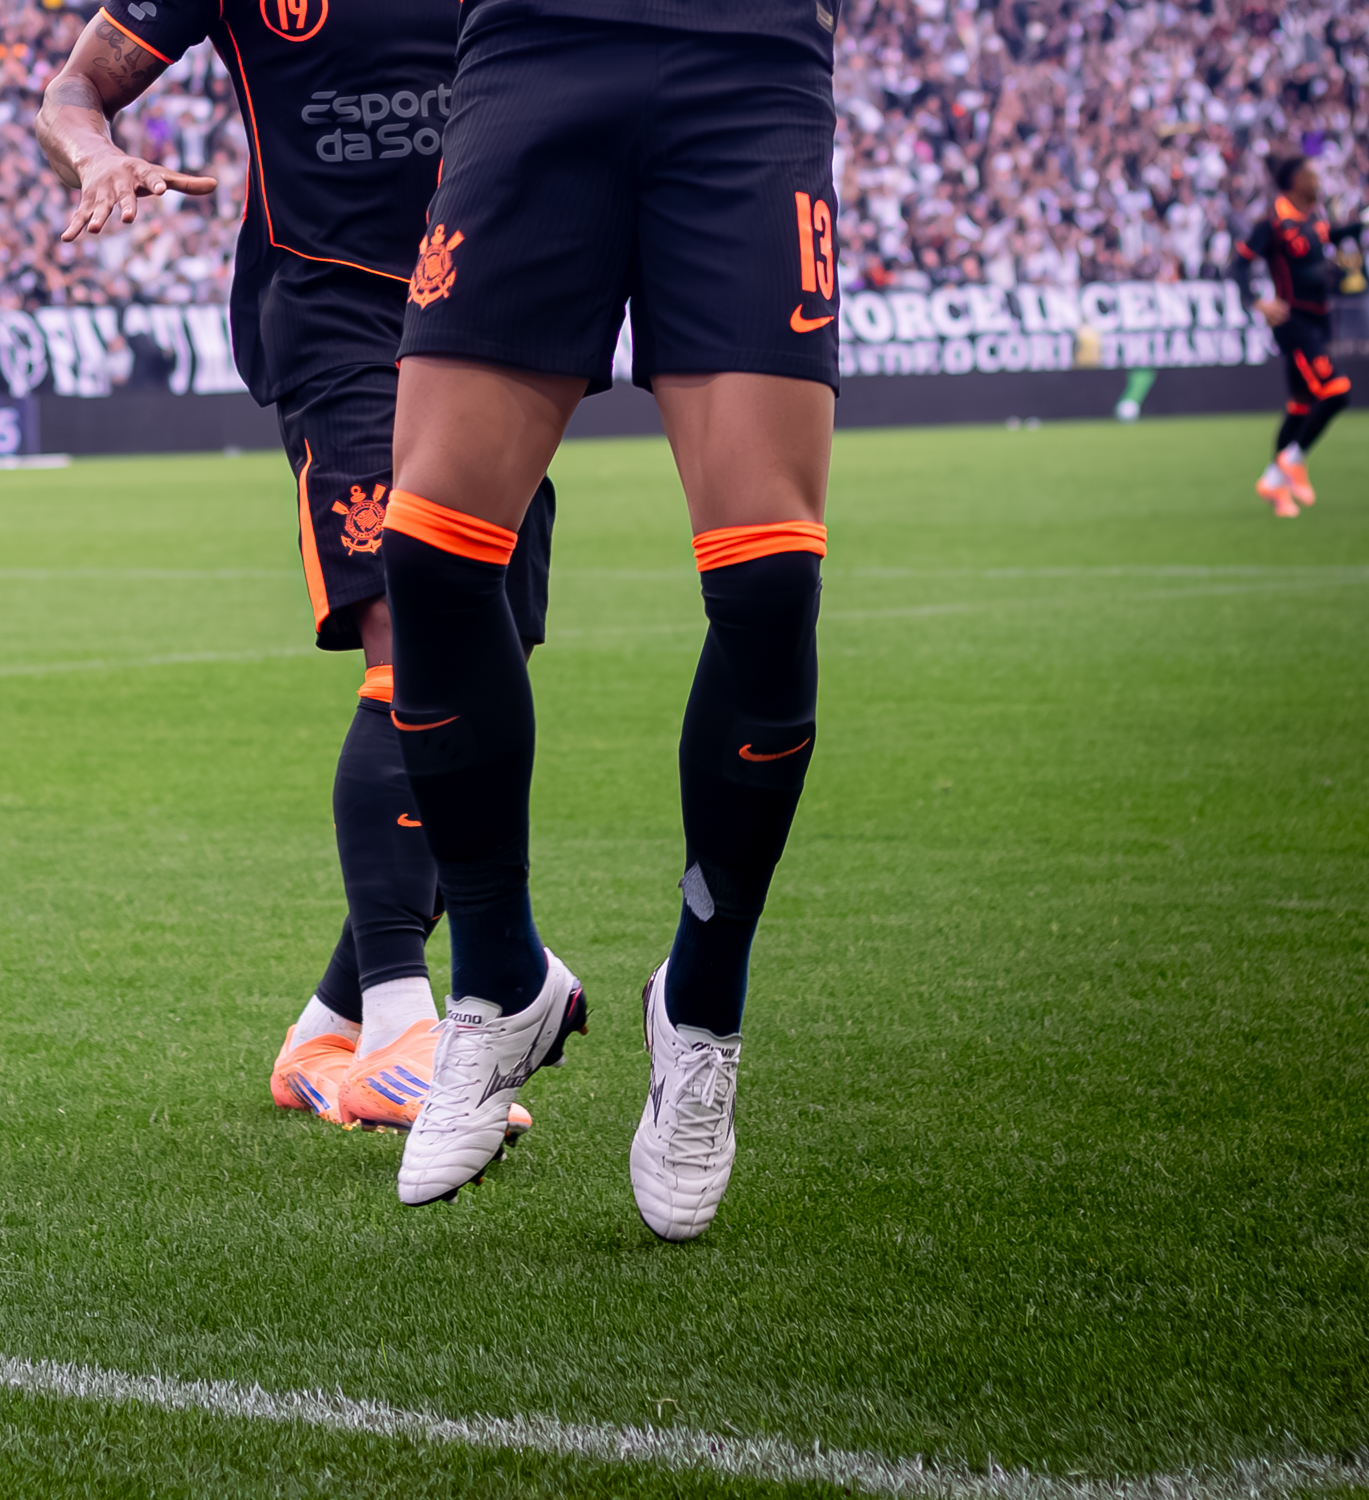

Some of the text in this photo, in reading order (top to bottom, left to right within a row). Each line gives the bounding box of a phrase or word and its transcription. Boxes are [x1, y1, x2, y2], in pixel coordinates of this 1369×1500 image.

[301, 83, 452, 131] Esport
[377, 121, 445, 160] So
[794, 191, 835, 301] 13
